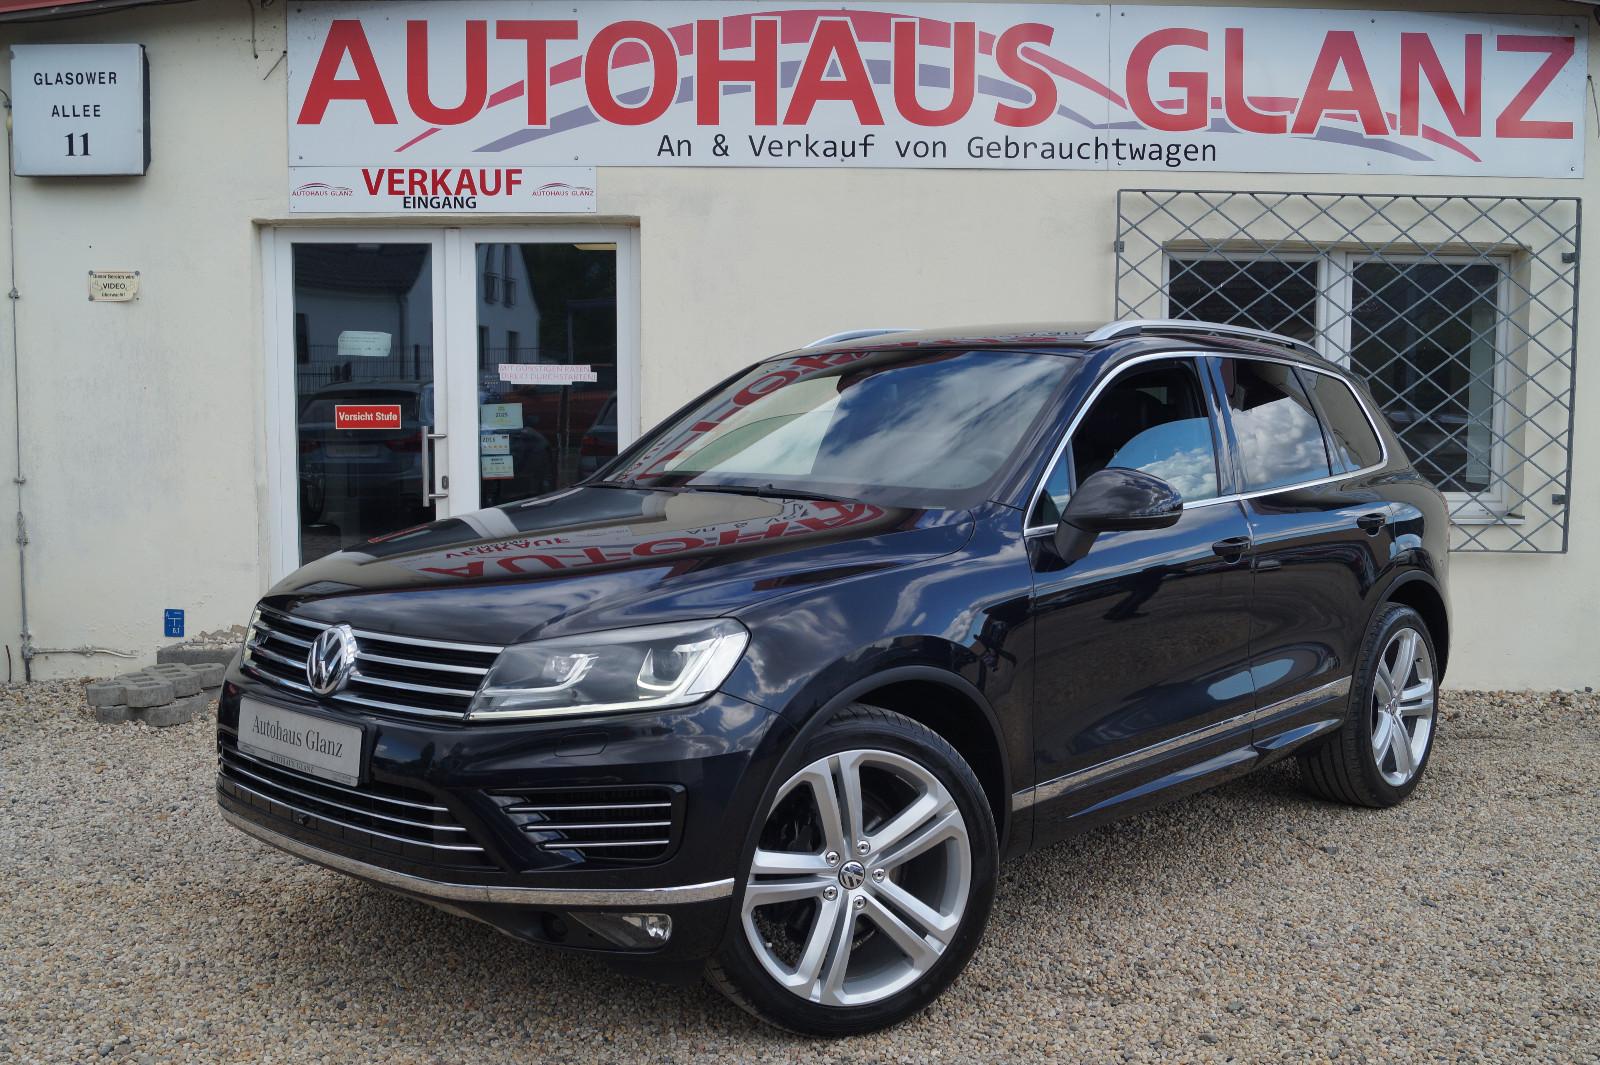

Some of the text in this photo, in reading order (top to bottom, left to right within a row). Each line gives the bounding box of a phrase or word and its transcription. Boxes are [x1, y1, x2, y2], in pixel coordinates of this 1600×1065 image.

[33, 71, 118, 86] GLASOWER
[297, 19, 1575, 140] AUTOHAUS GLANZ
[51, 104, 101, 118] ALLEE
[64, 132, 93, 157] 11
[656, 133, 1217, 168] An & Verkauf von Gebrauchtwagen
[361, 168, 523, 197] VERKAUF
[403, 196, 477, 209] EINGANG
[338, 411, 398, 421] Vorsicht Stufe
[252, 714, 343, 758] Autohaus Glanz
